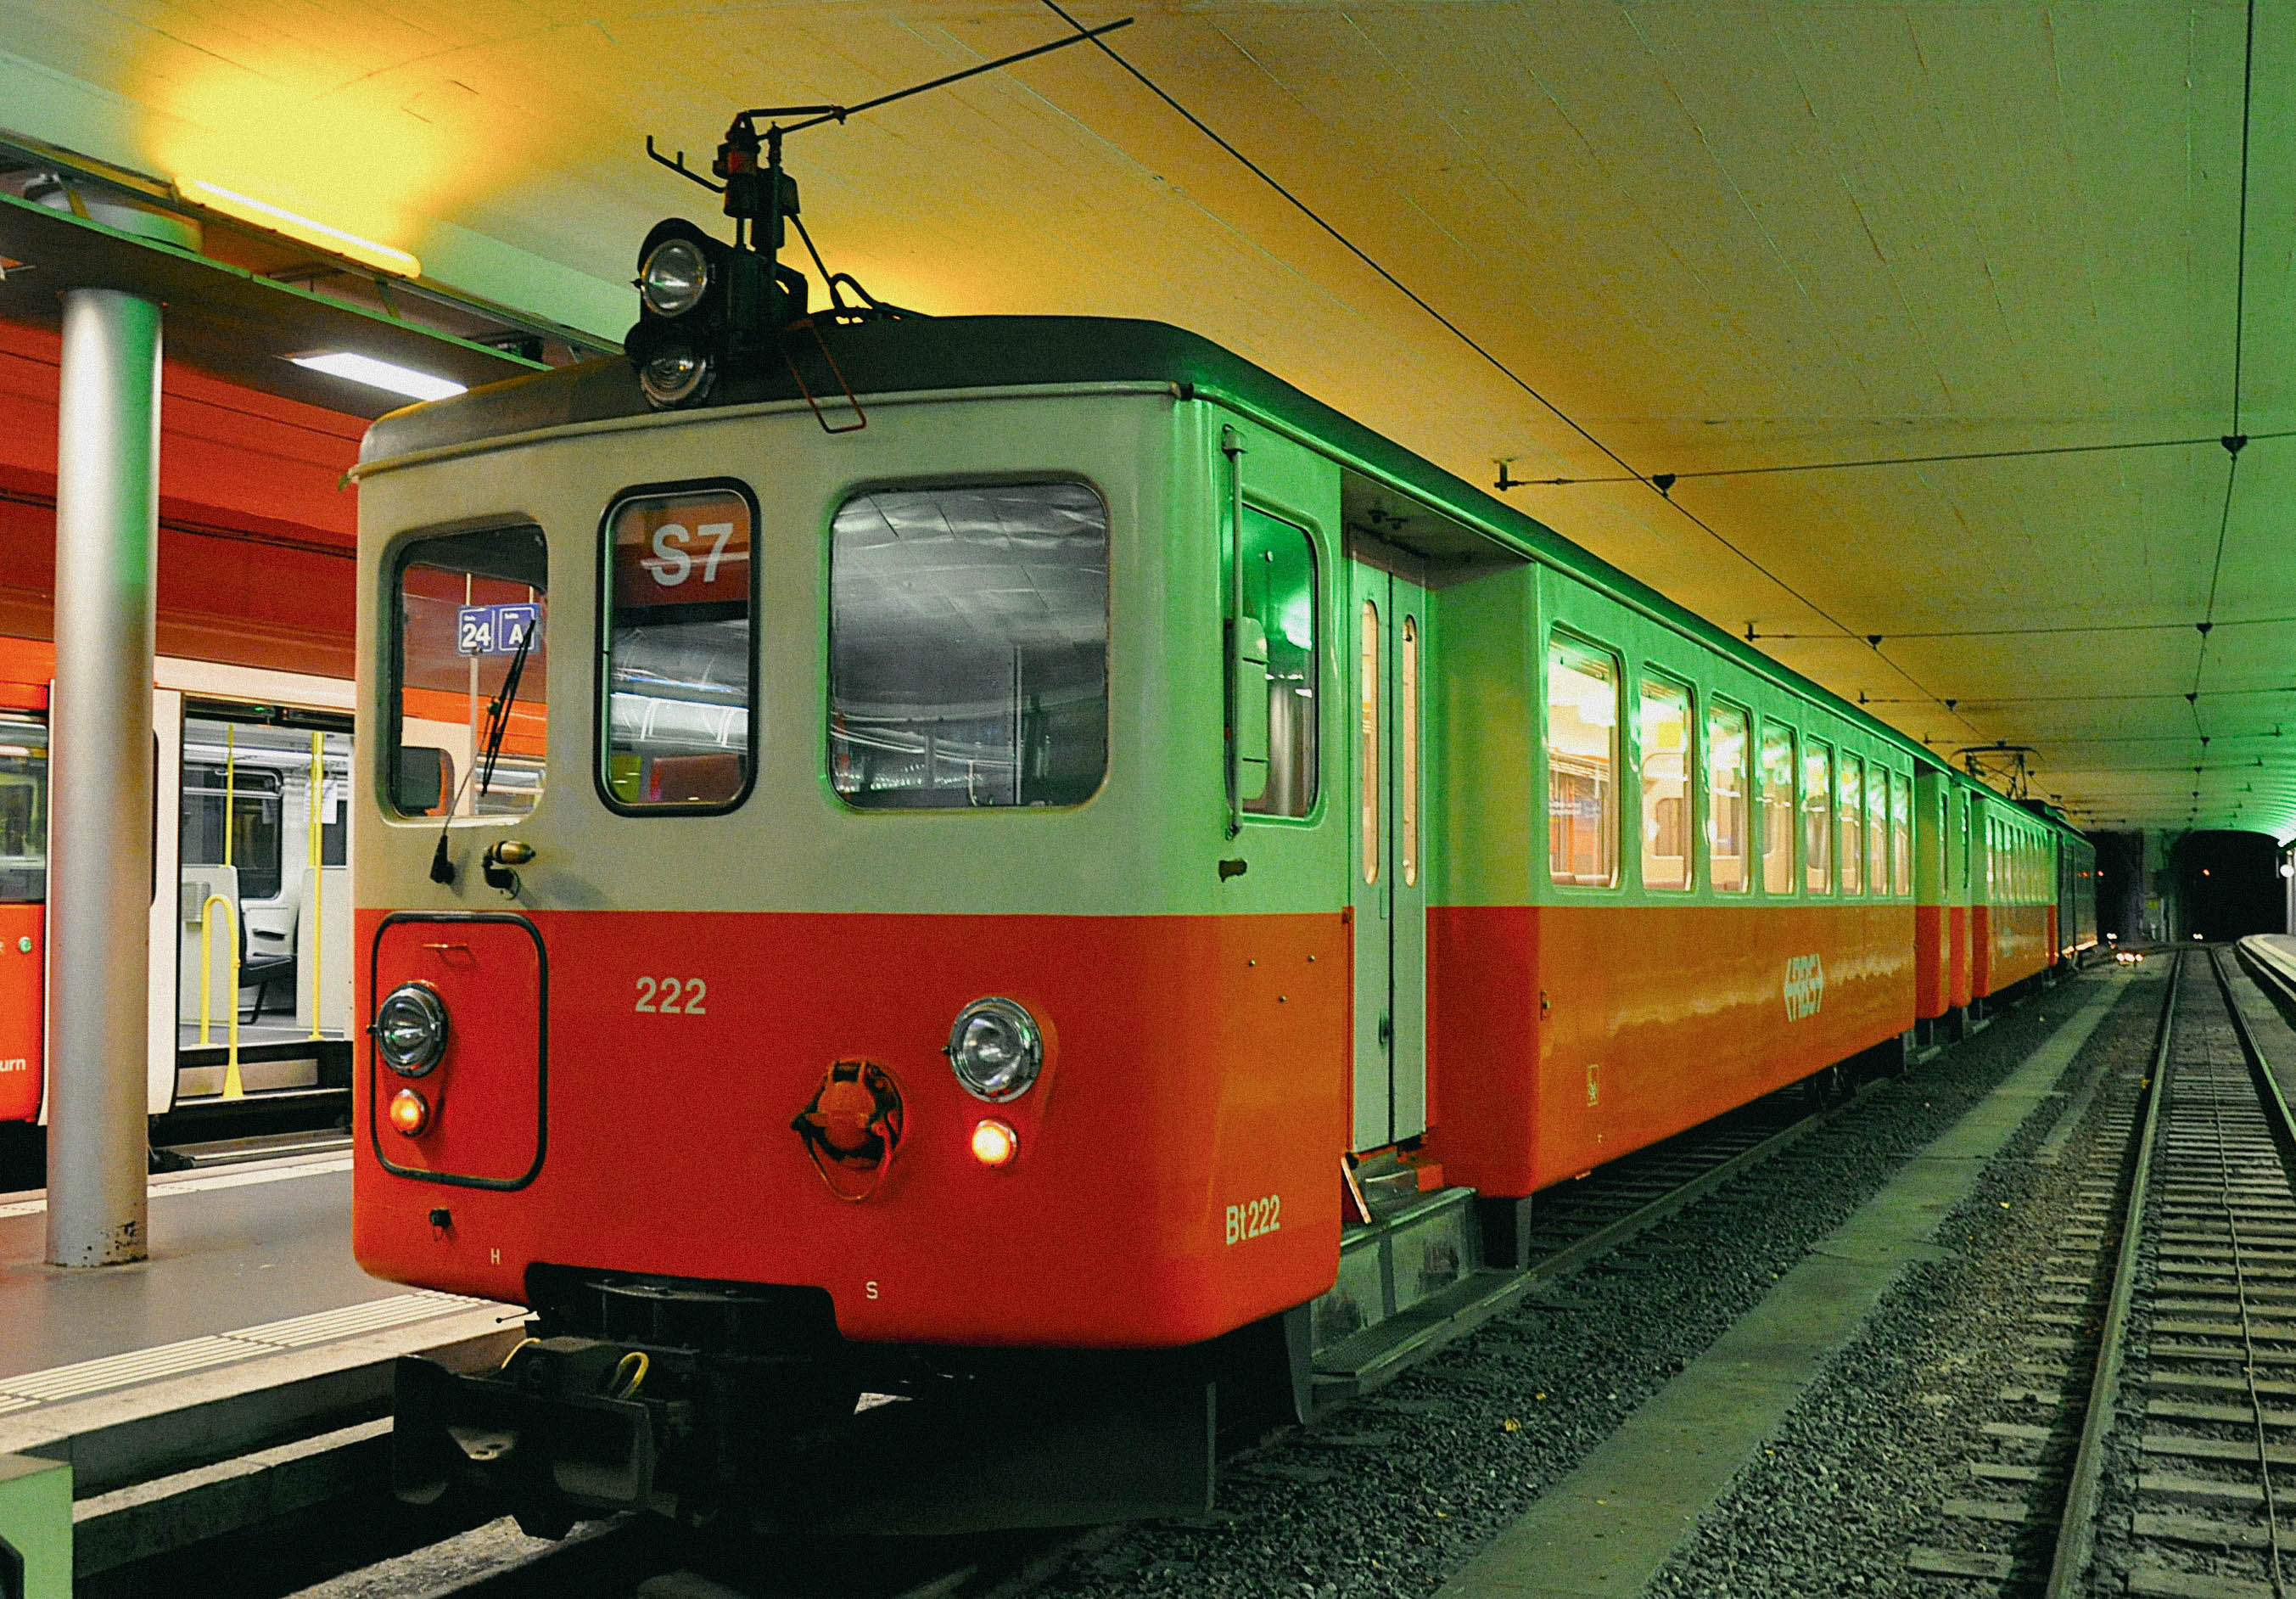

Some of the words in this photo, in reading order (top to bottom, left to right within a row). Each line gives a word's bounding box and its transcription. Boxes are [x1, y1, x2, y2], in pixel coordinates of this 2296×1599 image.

[652, 522, 734, 586] S7
[462, 622, 491, 648] 24
[508, 623, 524, 645] A
[636, 977, 707, 1015] 222
[490, 1248, 501, 1265] H
[865, 1281, 878, 1299] S
